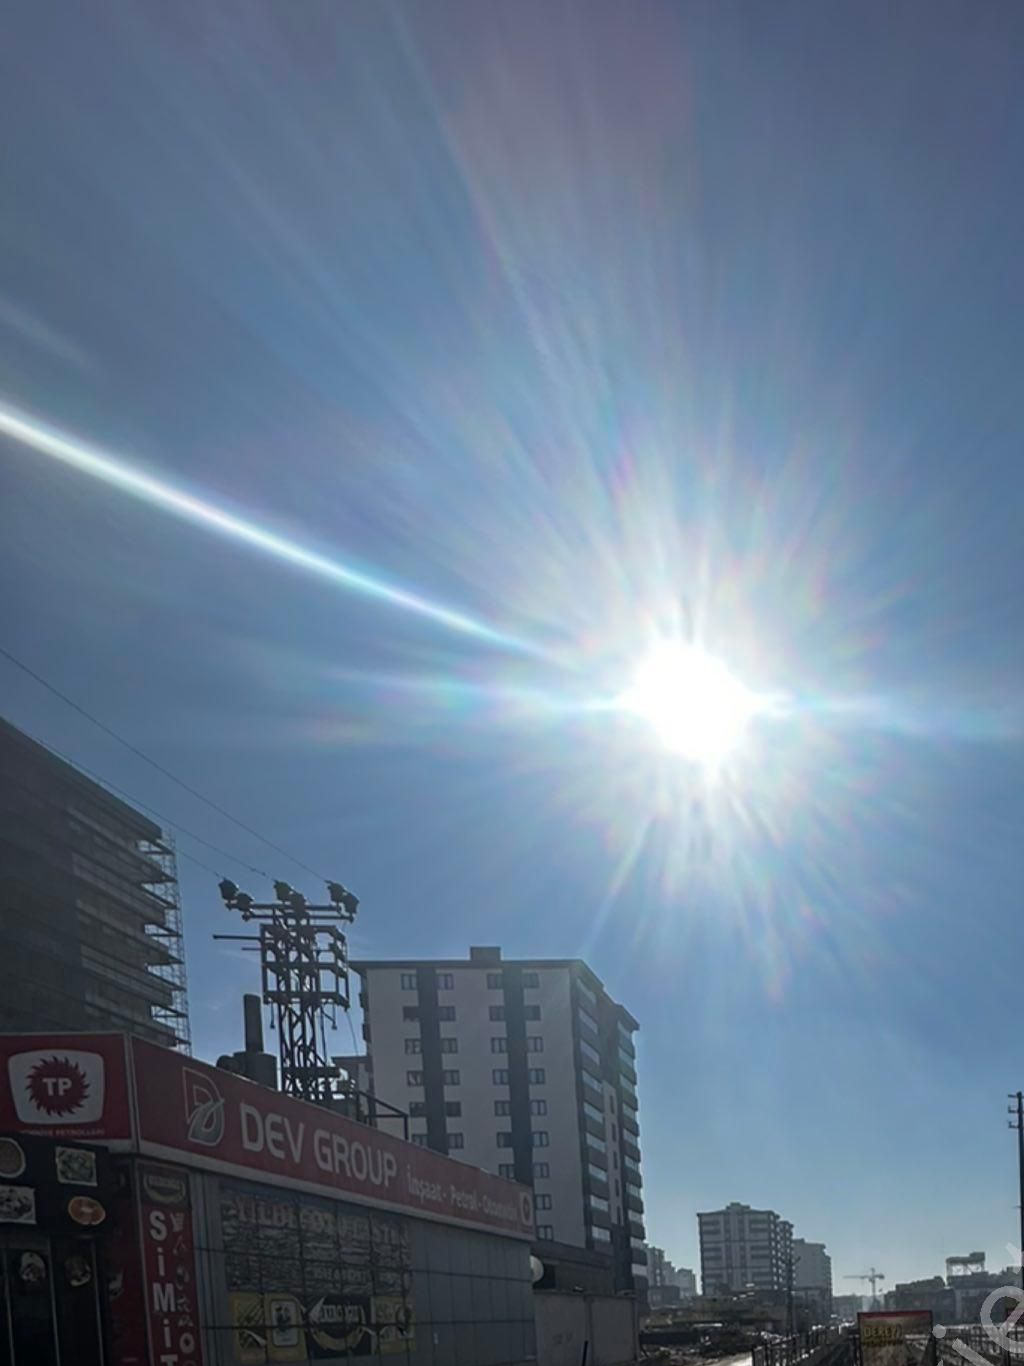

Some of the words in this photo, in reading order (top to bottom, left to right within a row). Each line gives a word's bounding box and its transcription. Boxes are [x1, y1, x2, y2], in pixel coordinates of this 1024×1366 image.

[43, 1077, 72, 1096] TP
[240, 1101, 304, 1164] DEV
[313, 1128, 397, 1187] GROUP
